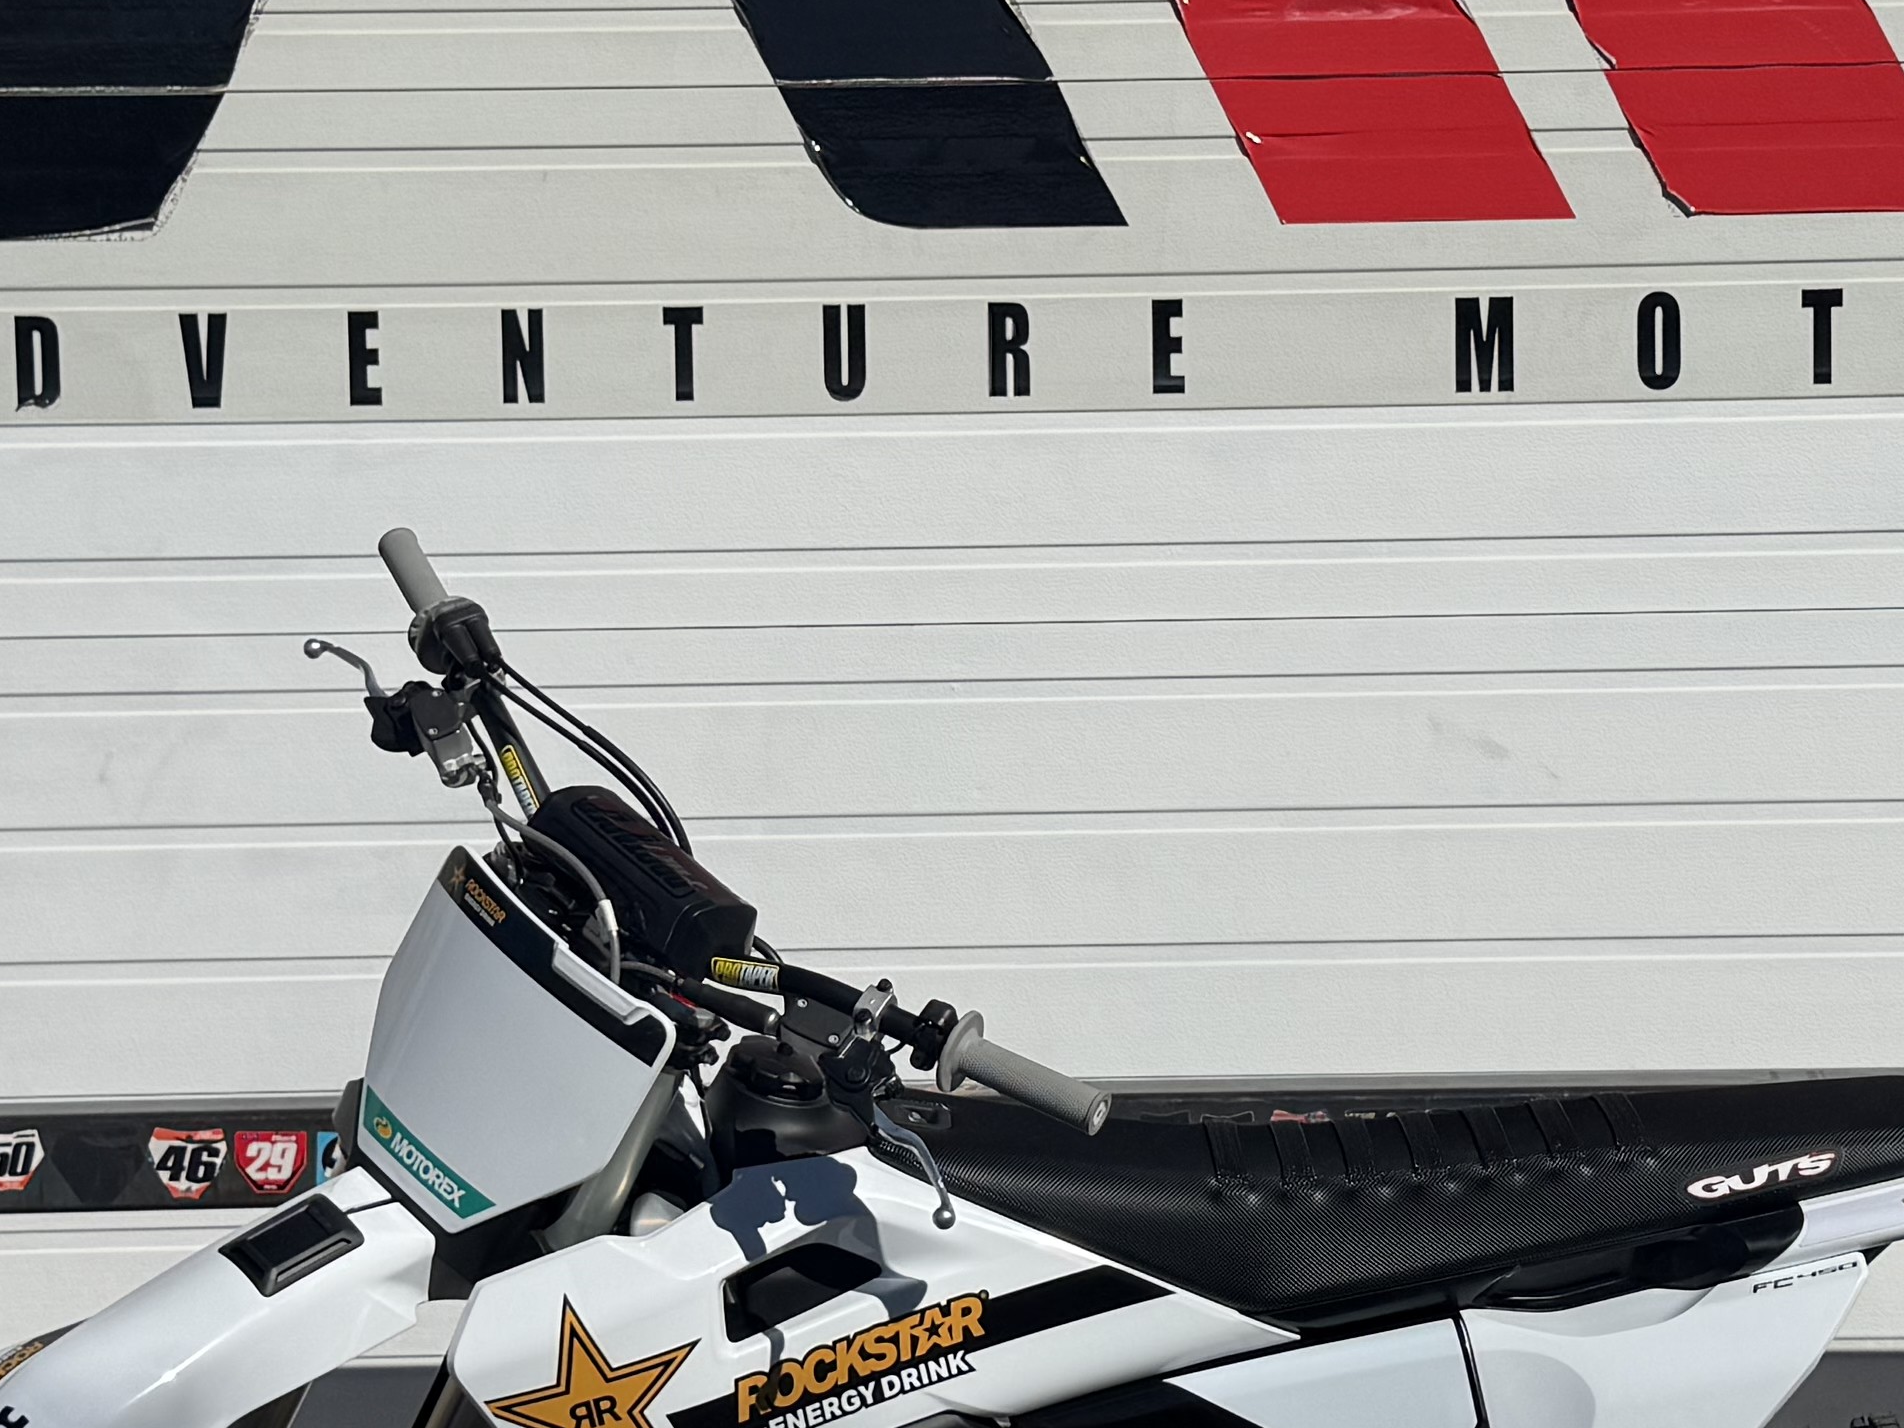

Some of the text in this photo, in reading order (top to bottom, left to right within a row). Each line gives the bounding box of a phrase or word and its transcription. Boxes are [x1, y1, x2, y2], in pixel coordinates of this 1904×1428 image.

[155, 1144, 220, 1184] 46
[245, 1141, 298, 1180] 29
[390, 1131, 467, 1210] MOTOREX
[1687, 1149, 1836, 1201] GUTS
[738, 1296, 986, 1424] ROCKSTAR
[880, 1350, 974, 1399] DRINK
